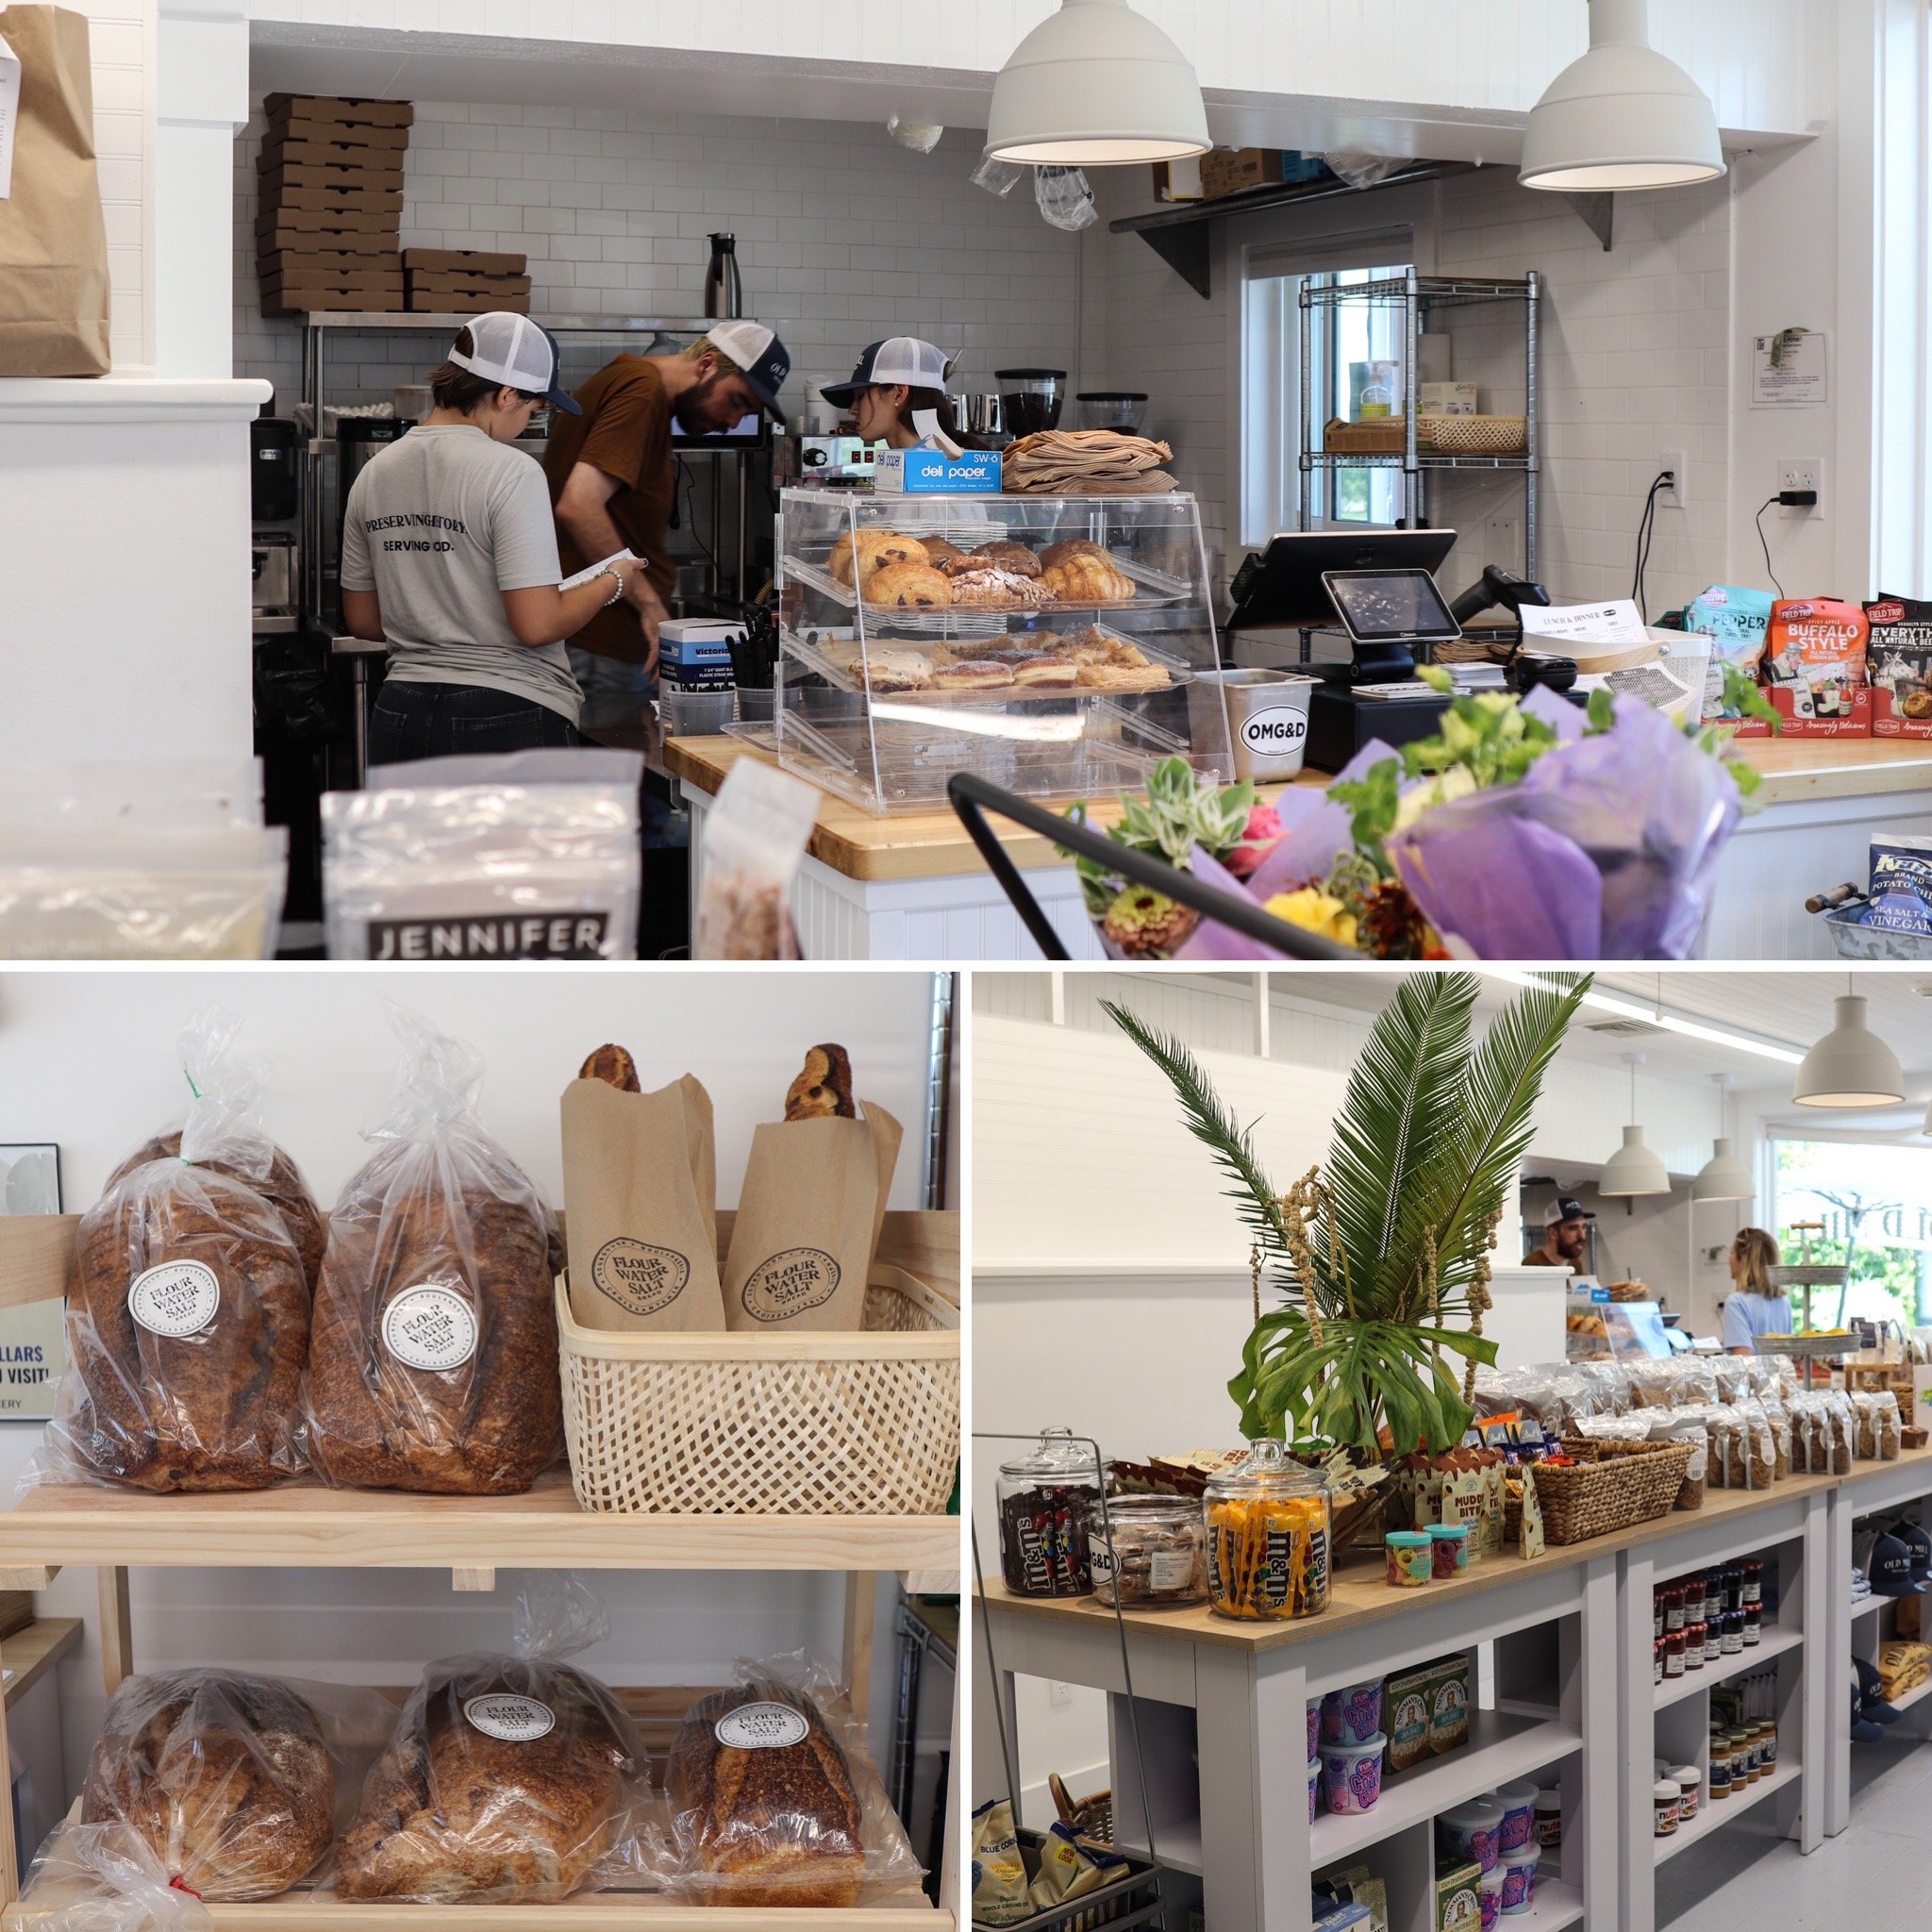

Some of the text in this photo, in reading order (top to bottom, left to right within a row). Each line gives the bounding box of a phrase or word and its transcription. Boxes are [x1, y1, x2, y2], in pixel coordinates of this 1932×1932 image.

[973, 453, 998, 464] SW-6
[921, 465, 987, 479] deli paper
[383, 541, 430, 552] SERVING
[1781, 609, 1799, 619] FIELD
[1869, 609, 1887, 618] FIELD
[1788, 624, 1858, 638] BUFFALO
[1798, 637, 1848, 650] STYLE
[1248, 722, 1305, 740] OMG&D
[1807, 721, 1838, 735] Amazingly
[1873, 880, 1911, 891] POTATO
[1894, 873, 1924, 884] BRAND
[1874, 906, 1892, 915] SEA
[1894, 908, 1921, 917] SALT
[1869, 915, 1932, 933] VINEGAR
[377, 918, 602, 960] JENNIFER
[612, 1257, 662, 1270] FLOUR
[764, 1259, 817, 1284] FLOUR
[615, 1266, 669, 1282] WATER
[764, 1270, 821, 1294] WATER
[149, 1276, 192, 1300] FLOUR
[628, 1277, 664, 1295] SALT
[774, 1281, 813, 1303] SALT
[153, 1285, 200, 1309] WATER
[165, 1297, 197, 1319] SALT
[402, 1304, 443, 1335] FLOUR
[408, 1314, 453, 1343] WATER
[424, 1327, 455, 1352] SALT
[498, 1719, 530, 1727] SALT
